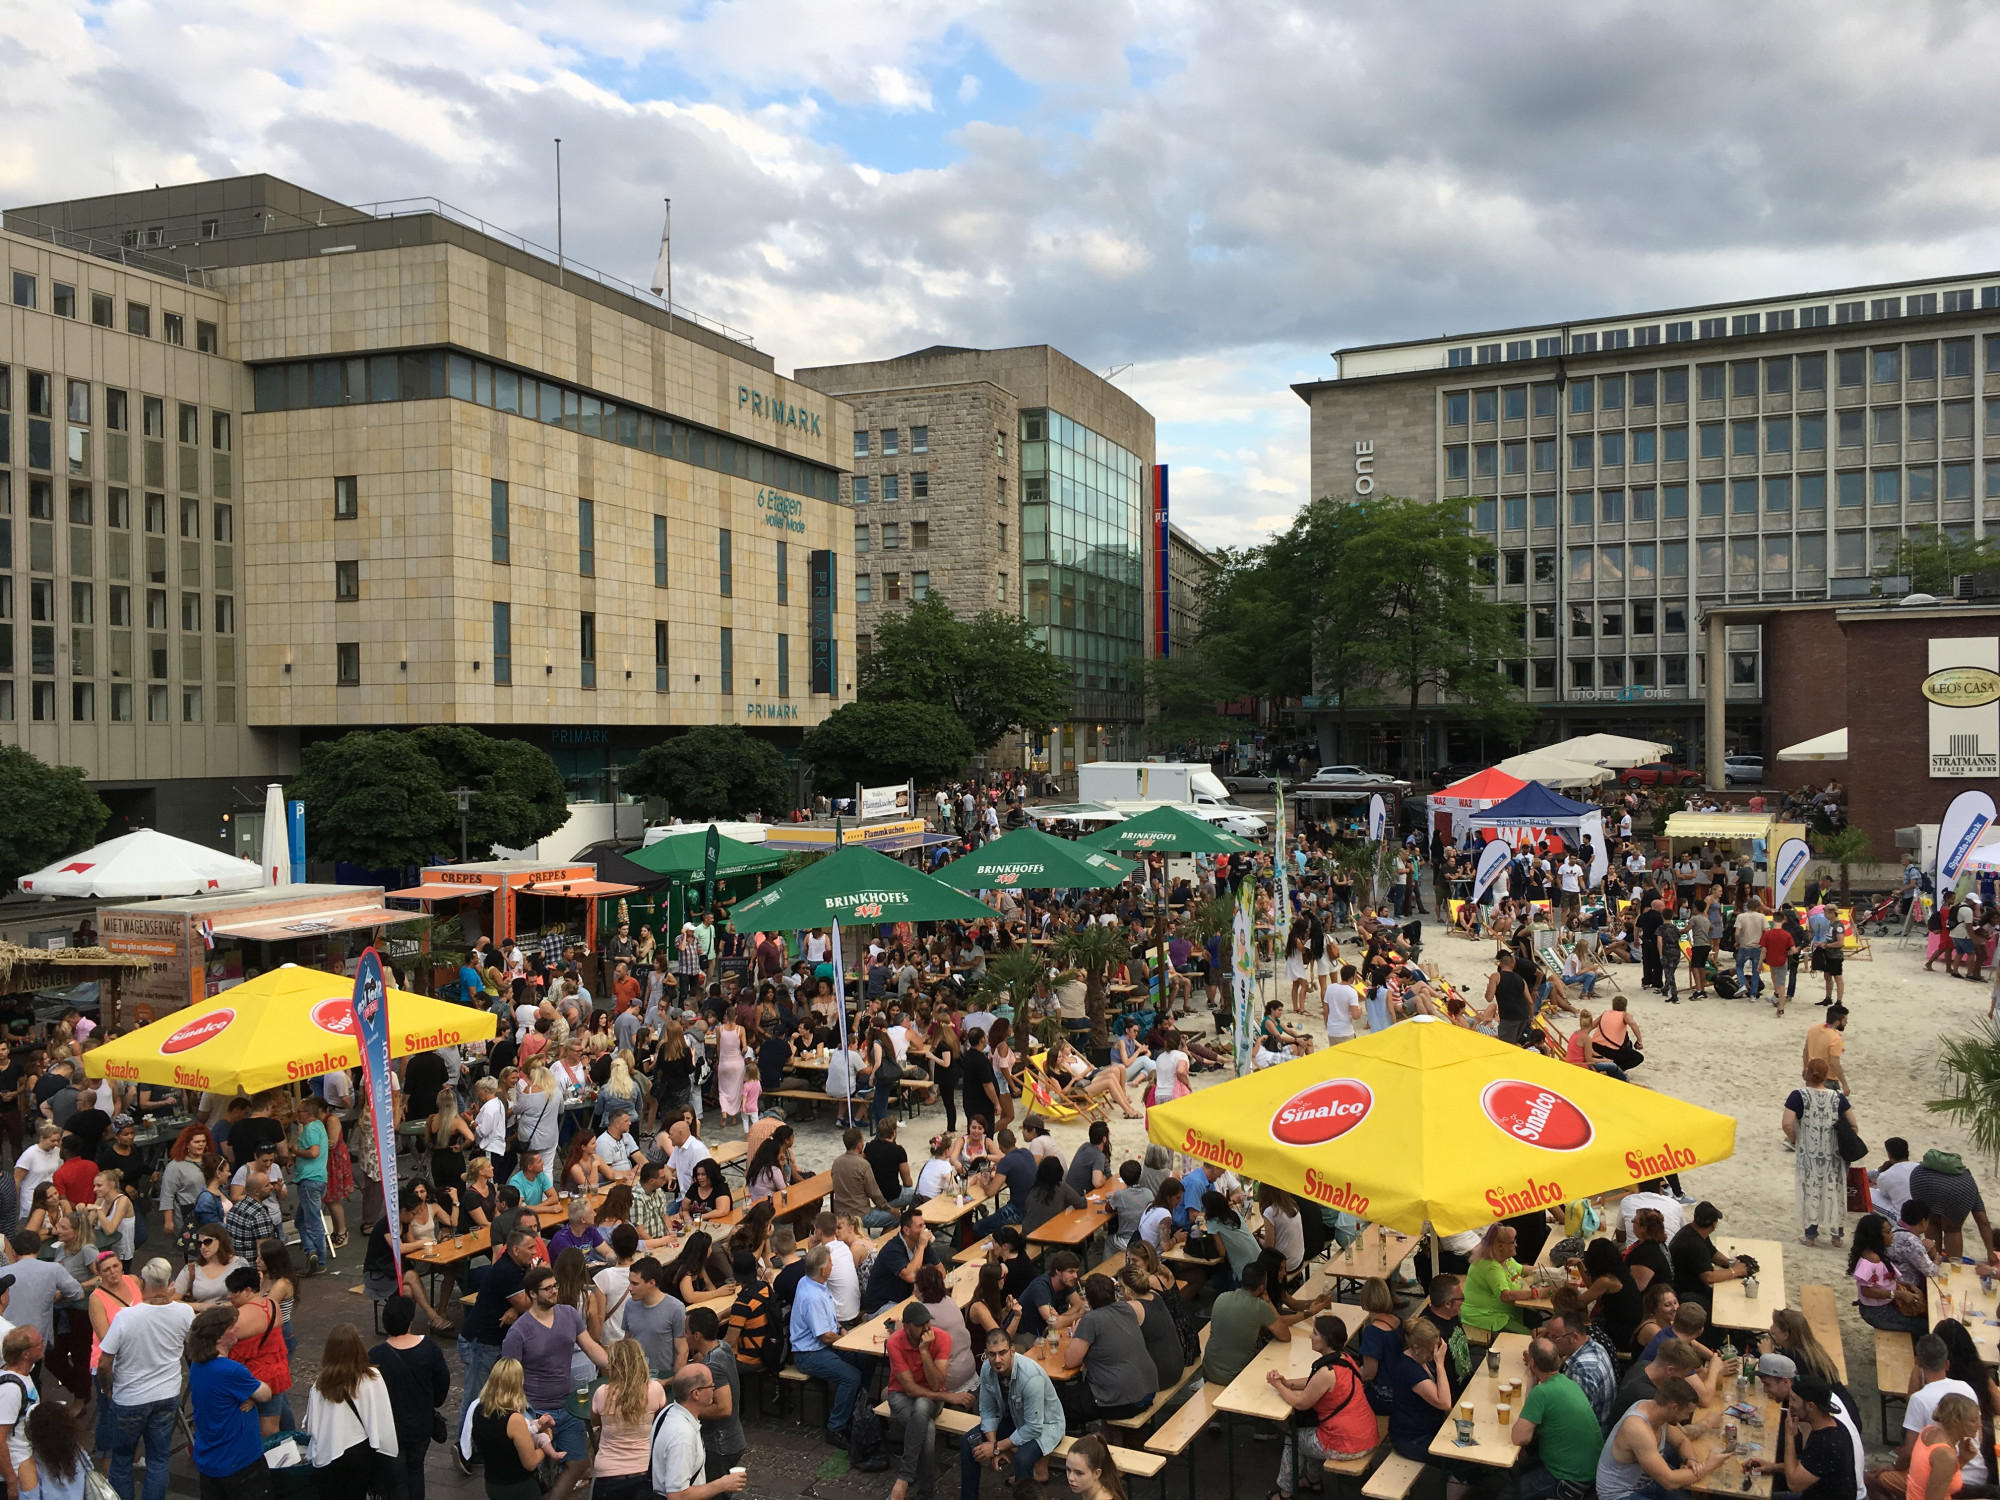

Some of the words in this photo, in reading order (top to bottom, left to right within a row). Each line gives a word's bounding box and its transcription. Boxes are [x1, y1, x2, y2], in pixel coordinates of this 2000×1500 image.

[738, 385, 821, 437] PRIMARK
[757, 488, 765, 507] 6
[767, 490, 802, 517] Etagen
[766, 513, 784, 528] voller
[786, 517, 805, 534] Mode
[815, 571, 828, 668] PRIMARK
[1964, 683, 1995, 694] CASA
[747, 703, 799, 720] PRIMARK
[551, 729, 608, 743] PRIMARK
[1932, 757, 1997, 766] STRATMANNS
[863, 798, 896, 809] Flammkuchen
[1433, 796, 1446, 806] WAZ
[1459, 799, 1473, 808] WAZ
[296, 806, 304, 819] P
[864, 826, 905, 838] Flammkuchen
[1949, 822, 1983, 870] Sparda-Bank
[441, 872, 482, 884] CREPES
[528, 871, 567, 882] CREPES
[825, 892, 909, 908] BRINKHOFF's
[104, 917, 181, 936] MIETWAGENSERVICE
[22, 974, 69, 991] AUSGABE
[168, 1020, 227, 1044] Sinalco
[405, 1028, 460, 1052] Sinalco
[105, 1058, 139, 1080] Sinalco
[286, 1053, 348, 1080] Sinalco
[173, 1065, 210, 1090] Sinalco
[1278, 1099, 1364, 1124] Sinalco
[1512, 1091, 1557, 1141] Sinalco
[1181, 1128, 1244, 1170] Sinalco
[1625, 1143, 1697, 1180] Sinalco
[1303, 1167, 1370, 1216] Sinalco
[1485, 1178, 1564, 1218] Sinalco
